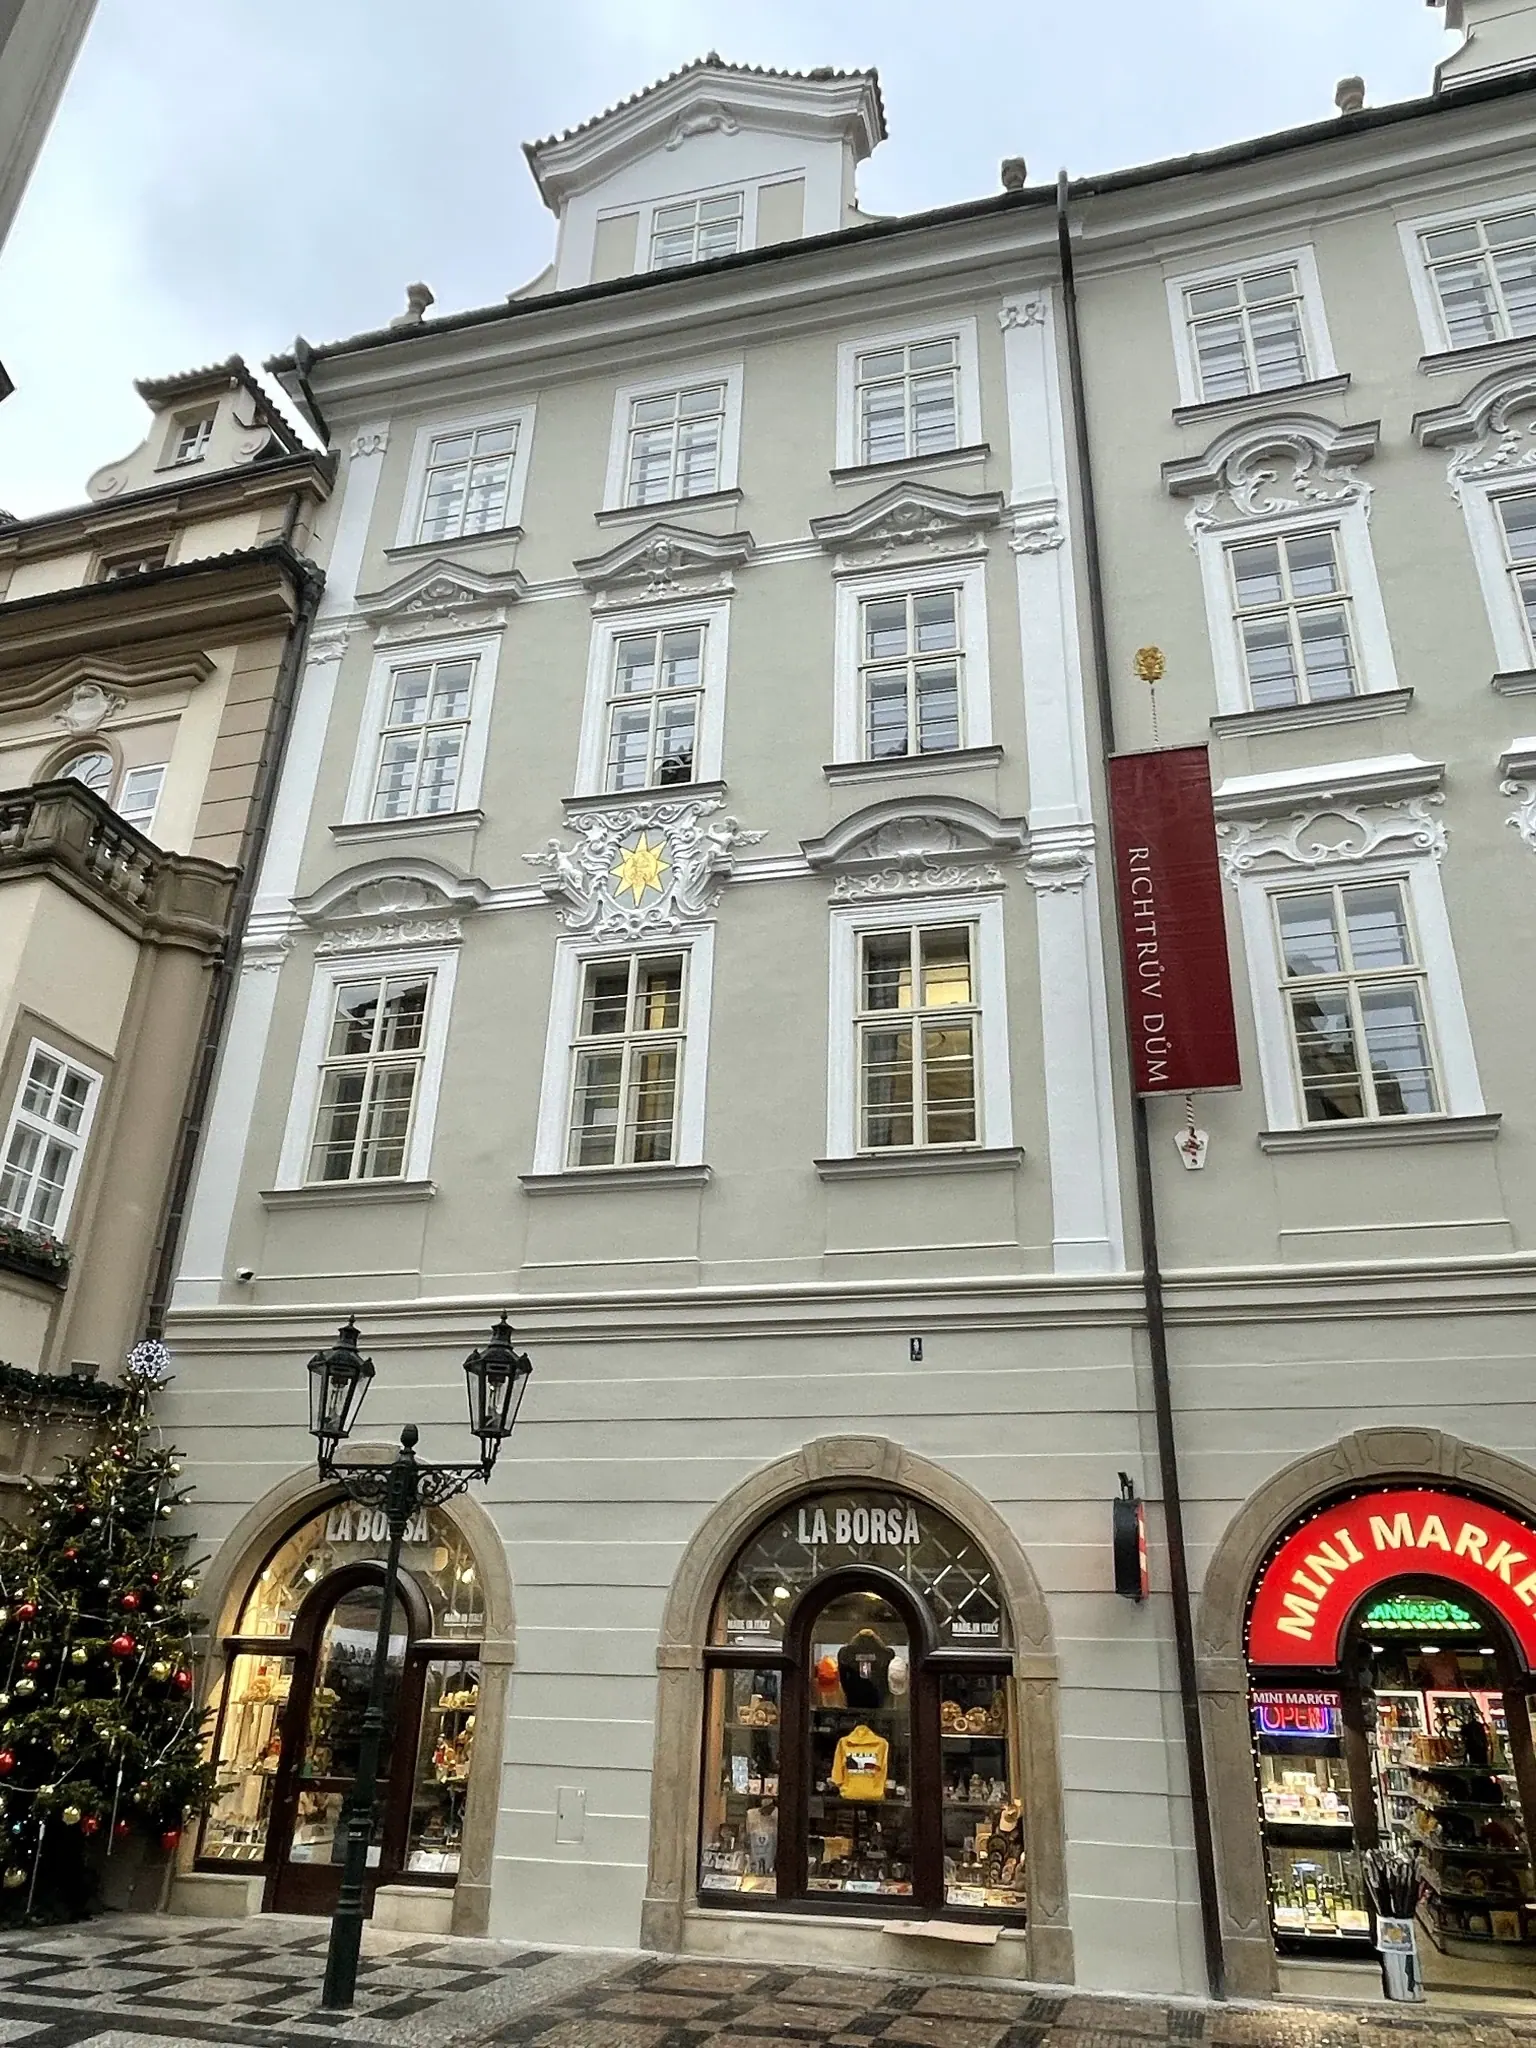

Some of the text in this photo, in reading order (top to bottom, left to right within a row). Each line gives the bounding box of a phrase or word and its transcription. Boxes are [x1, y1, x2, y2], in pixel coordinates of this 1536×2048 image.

[1128, 846, 1172, 1083] RICHTRŮV DŮM
[325, 1507, 429, 1542] LA BOSA
[798, 1507, 920, 1544] LA BORSA
[1276, 1512, 1536, 1641] MINI MARKE
[1253, 1692, 1338, 1706] MINI MARKET
[1263, 1706, 1325, 1731] OPEN
